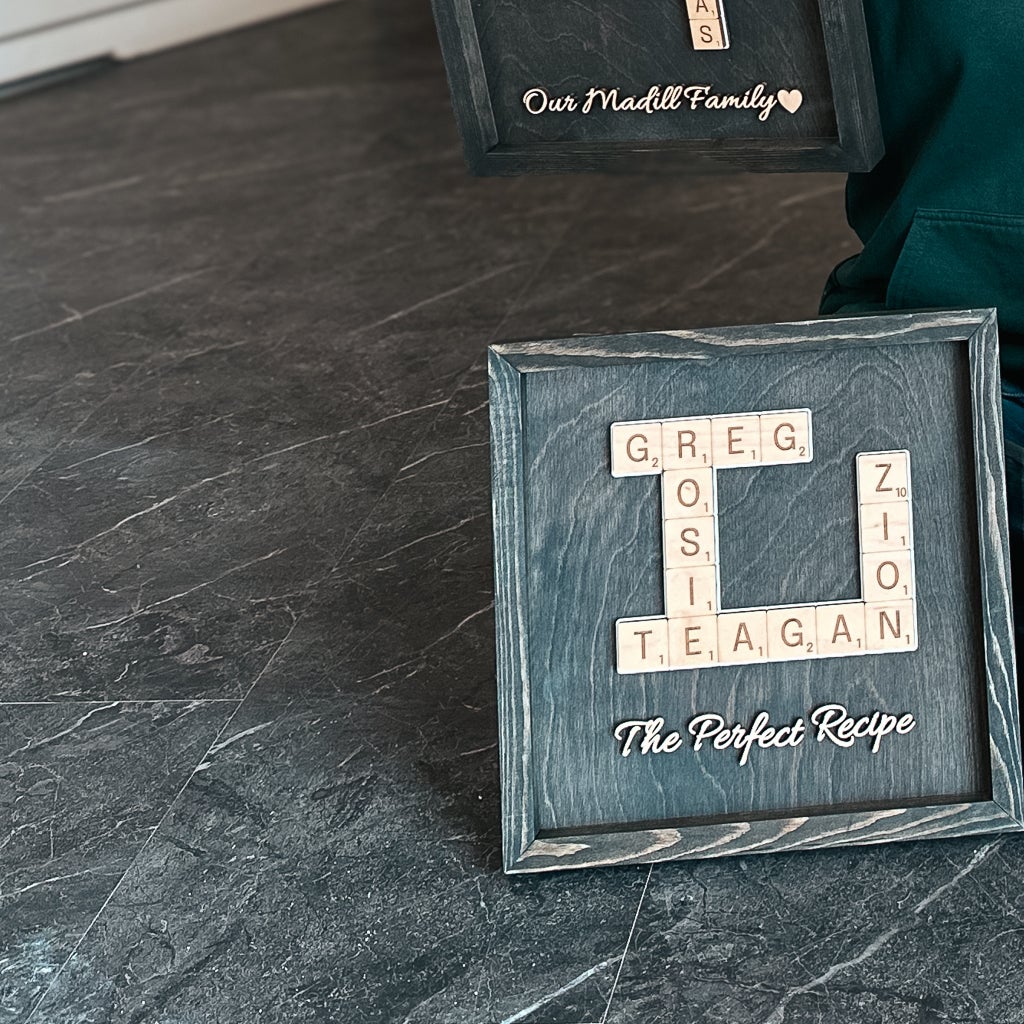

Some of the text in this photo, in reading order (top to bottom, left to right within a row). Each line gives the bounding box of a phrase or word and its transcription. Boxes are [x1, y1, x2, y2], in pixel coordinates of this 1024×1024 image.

[522, 83, 778, 121] Our Madill Family
[625, 421, 807, 469] GREG
[676, 429, 715, 661] ROSIE
[874, 462, 911, 646] ZION
[633, 609, 912, 666] TEAGAN
[613, 703, 917, 767] The Perfect Recipe
